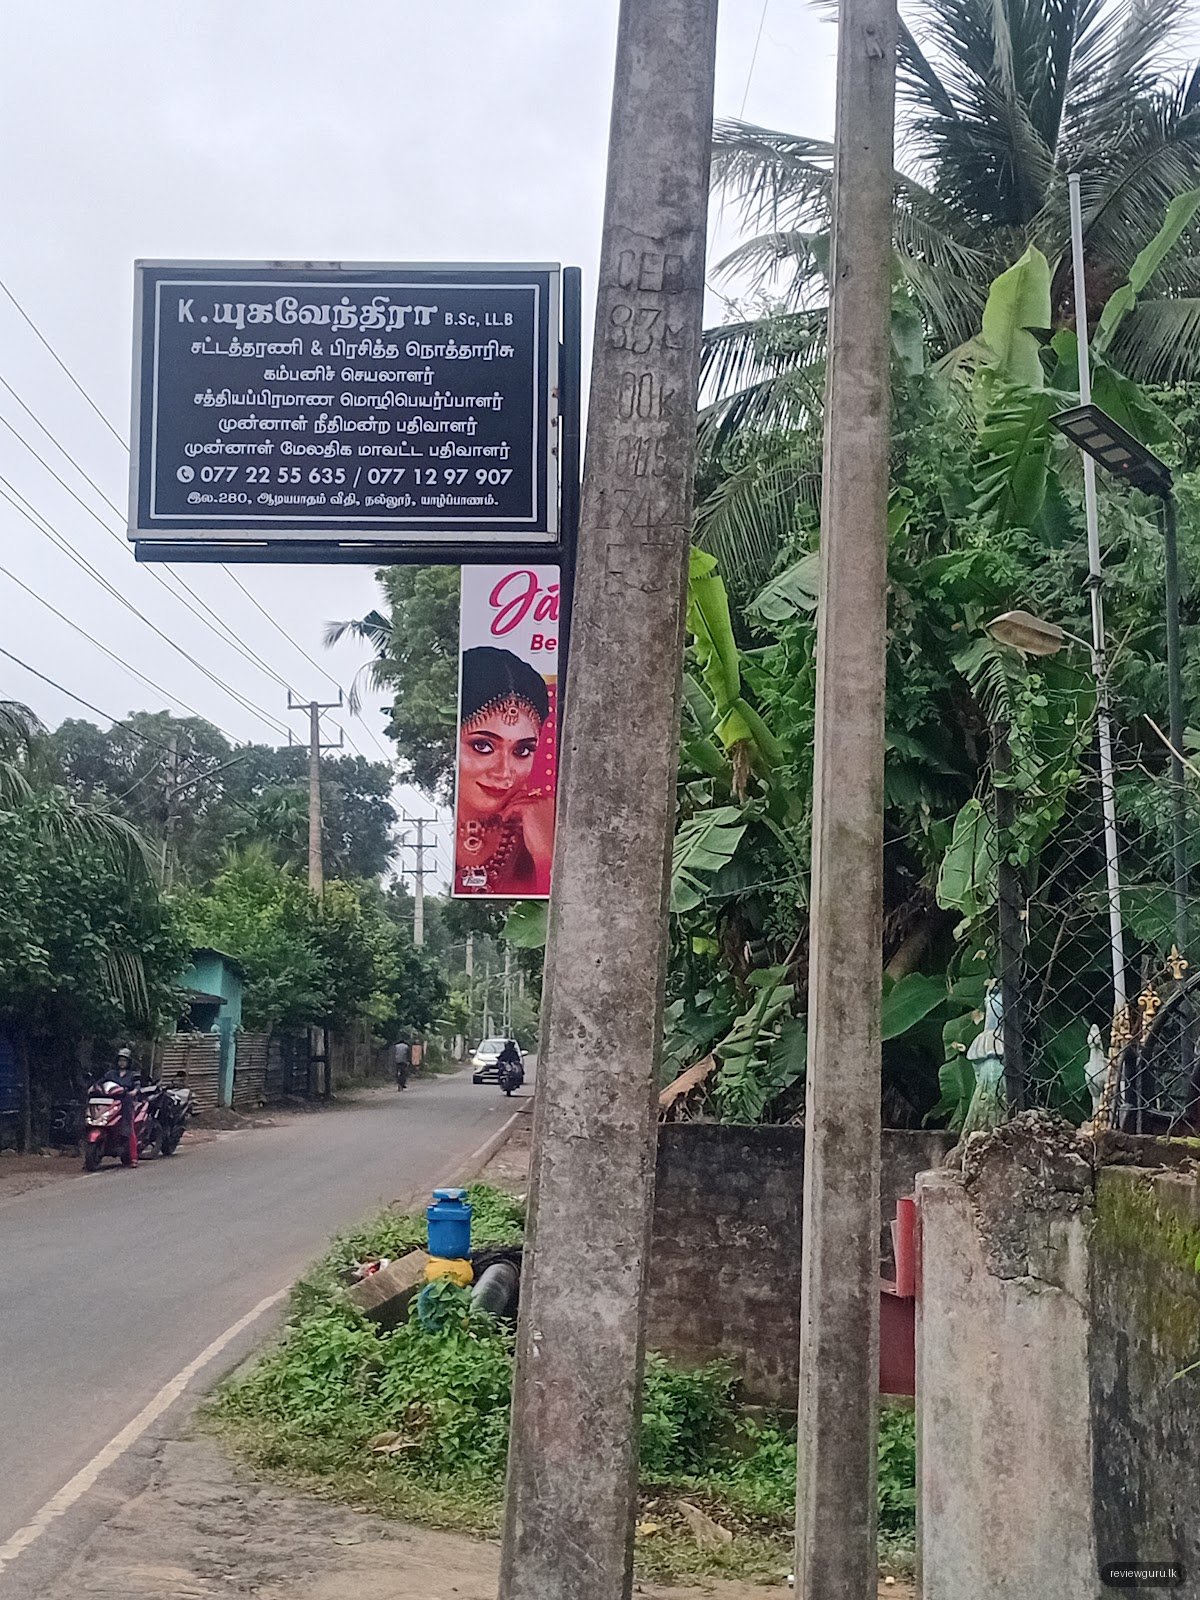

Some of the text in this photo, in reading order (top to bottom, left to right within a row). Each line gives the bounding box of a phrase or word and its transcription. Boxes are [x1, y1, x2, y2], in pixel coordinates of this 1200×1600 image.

[444, 312, 481, 328] B.Sc,
[190, 335, 515, 361] சட்டத்தரணி & பிரசித்த நொத்தாரிசு
[263, 364, 435, 386] கம்பனிச் செயலாளர்
[193, 388, 504, 411] சத்தியப்பிரமாண மொழிபெயர்ப்பாளர்
[218, 412, 479, 436] முன்னாள் நீதிமன்ற பதிவாளர்
[184, 438, 511, 460] முன்னாள் மேலதிக மாவட்ட பதிவாளர்
[200, 466, 514, 489] 077 22 55 635 / 077 12 97 907
[329, 491, 361, 507] வீதி,
[364, 493, 417, 509] நல்லூர்,
[420, 493, 499, 508] யாழ்ப்பாணம்.
